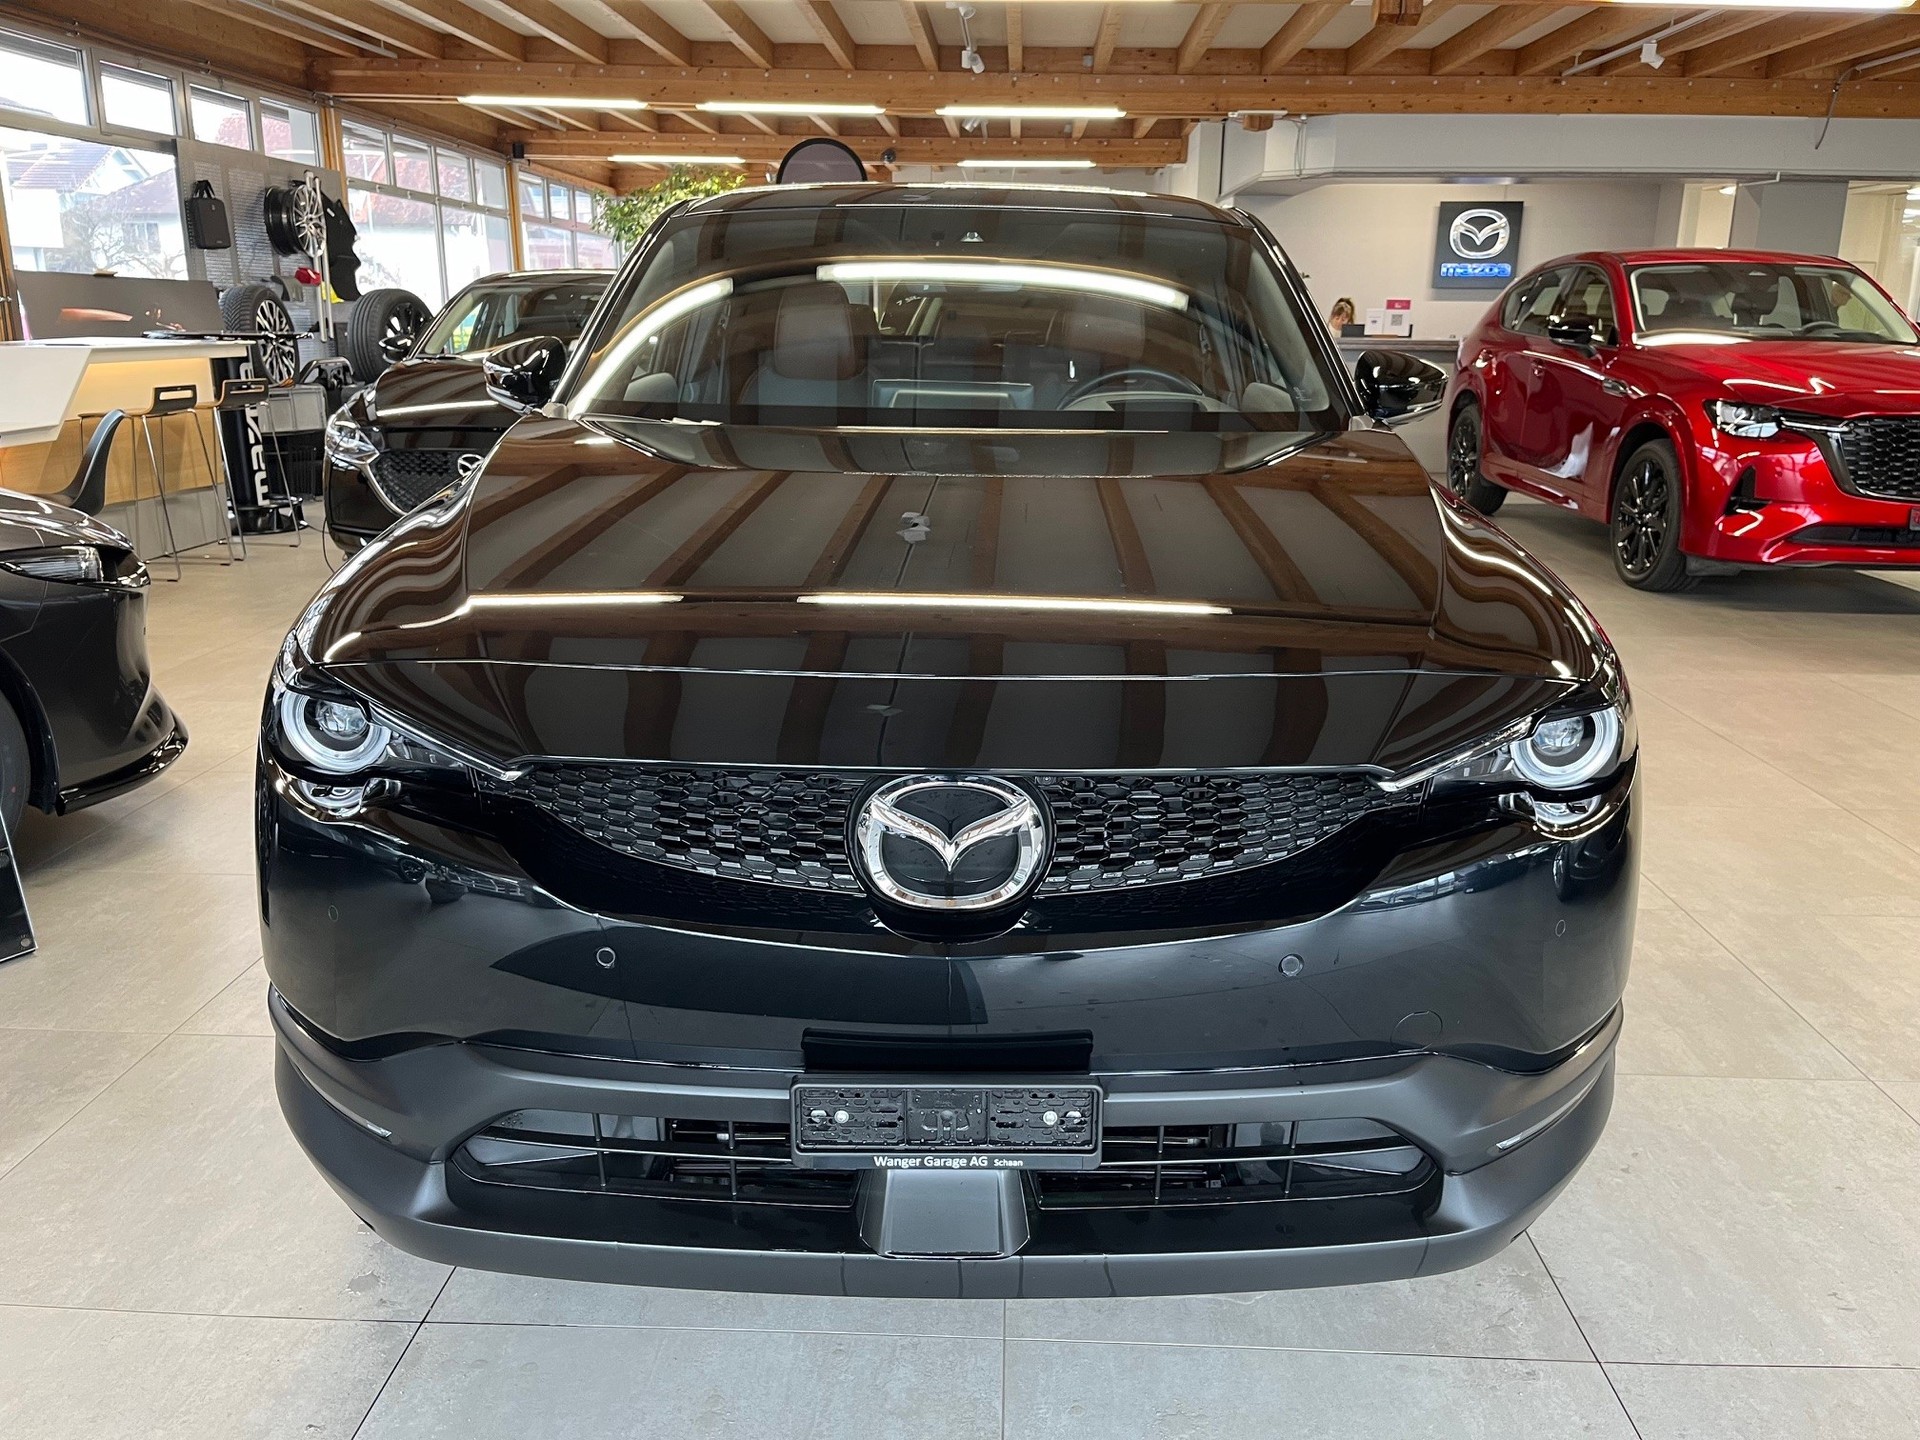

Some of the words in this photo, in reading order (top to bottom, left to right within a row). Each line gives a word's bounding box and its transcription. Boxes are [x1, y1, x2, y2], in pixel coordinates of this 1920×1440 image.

[1440, 263, 1511, 277] mazda
[239, 362, 270, 507] maza
[873, 1156, 922, 1168] Wanger
[923, 1156, 967, 1168] Garage
[969, 1156, 988, 1167] AG
[993, 1158, 1024, 1167] Schaan
